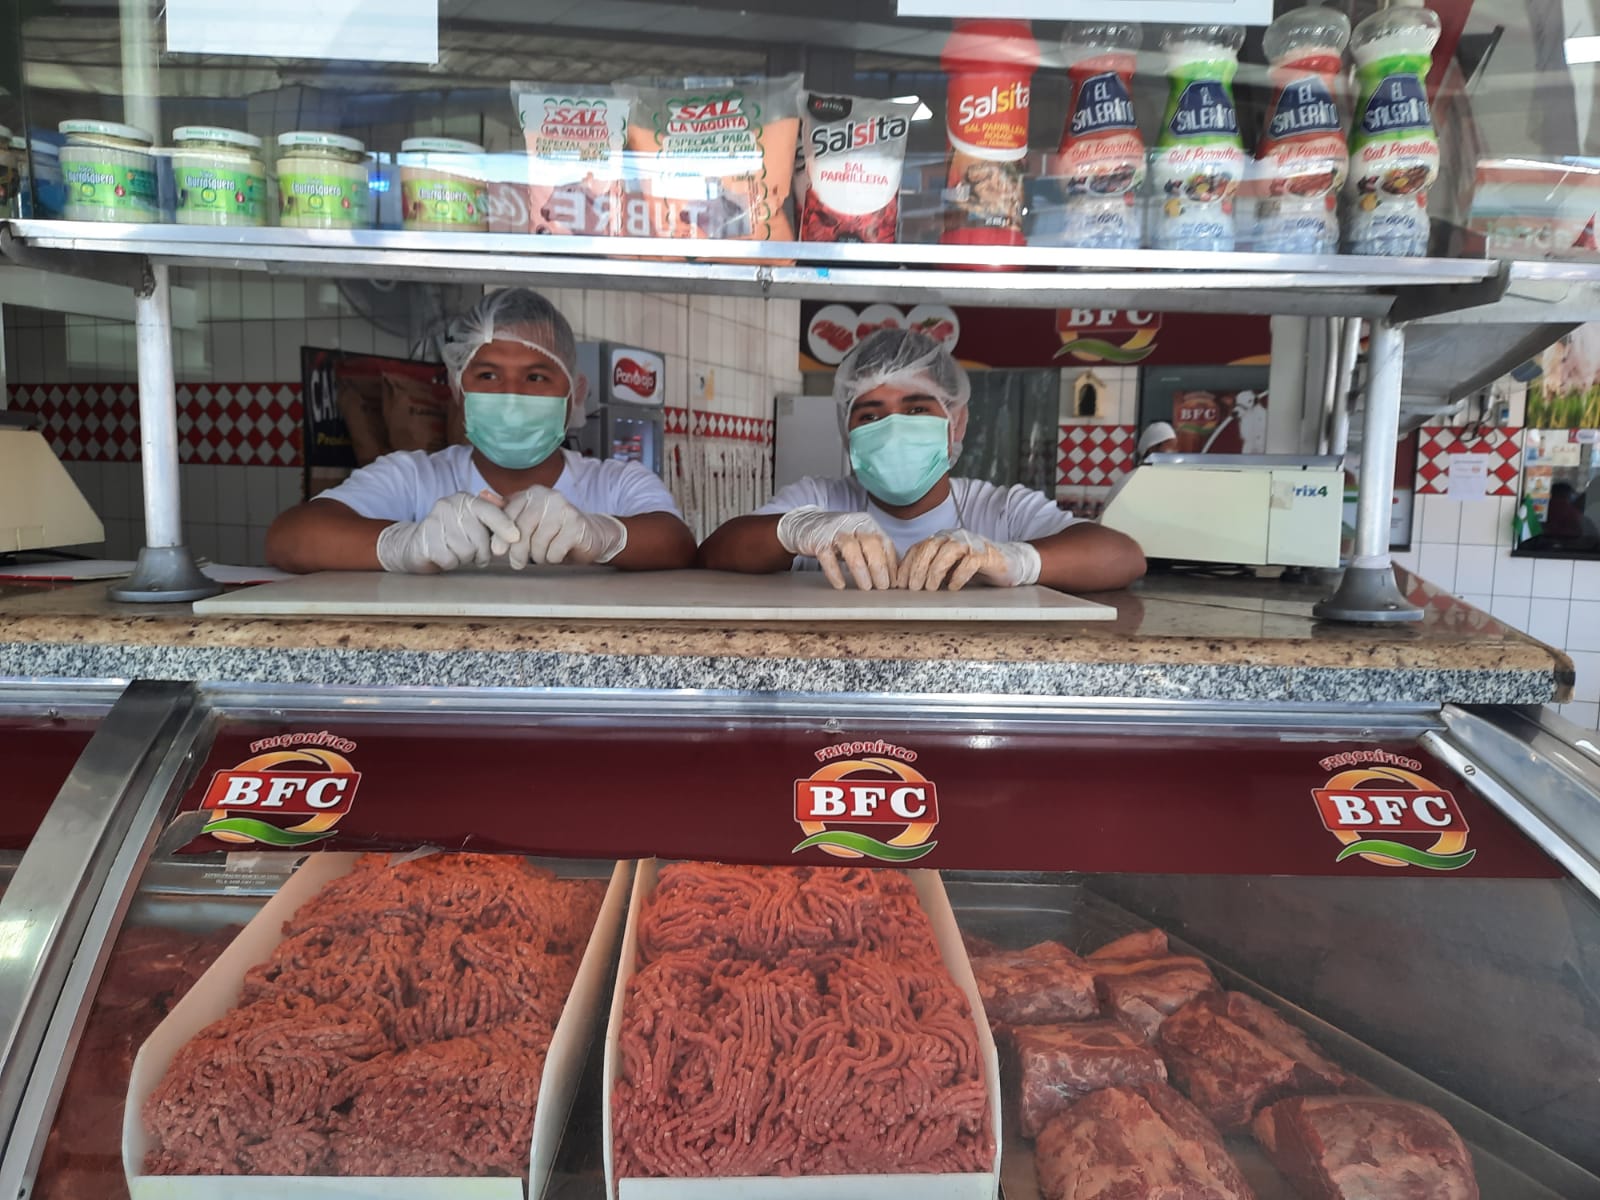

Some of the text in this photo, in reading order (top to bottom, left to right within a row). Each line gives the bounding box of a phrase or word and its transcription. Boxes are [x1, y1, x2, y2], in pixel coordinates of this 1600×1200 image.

[1094, 82, 1111, 102] EL
[1298, 84, 1316, 104] EL
[1391, 82, 1407, 102] EL
[676, 99, 738, 120] SAL
[959, 80, 1030, 126] Salsita
[551, 108, 606, 126] SAL
[670, 115, 746, 133] LA VAQUITA
[545, 126, 559, 137] LA
[721, 132, 751, 145] PARA
[811, 116, 907, 158] Salsita
[820, 170, 889, 185] PARRILLERA
[844, 162, 864, 174] SAL
[1067, 308, 1153, 327] BFC
[1181, 407, 1216, 420] BFC
[250, 730, 357, 753] FRIGORÍFICO
[814, 739, 918, 762] FRIGORÍFICO
[1318, 748, 1423, 772] FRIGORÍFICO
[217, 776, 348, 808] BFC
[809, 785, 927, 818] BFC
[1328, 795, 1453, 827] BFC
